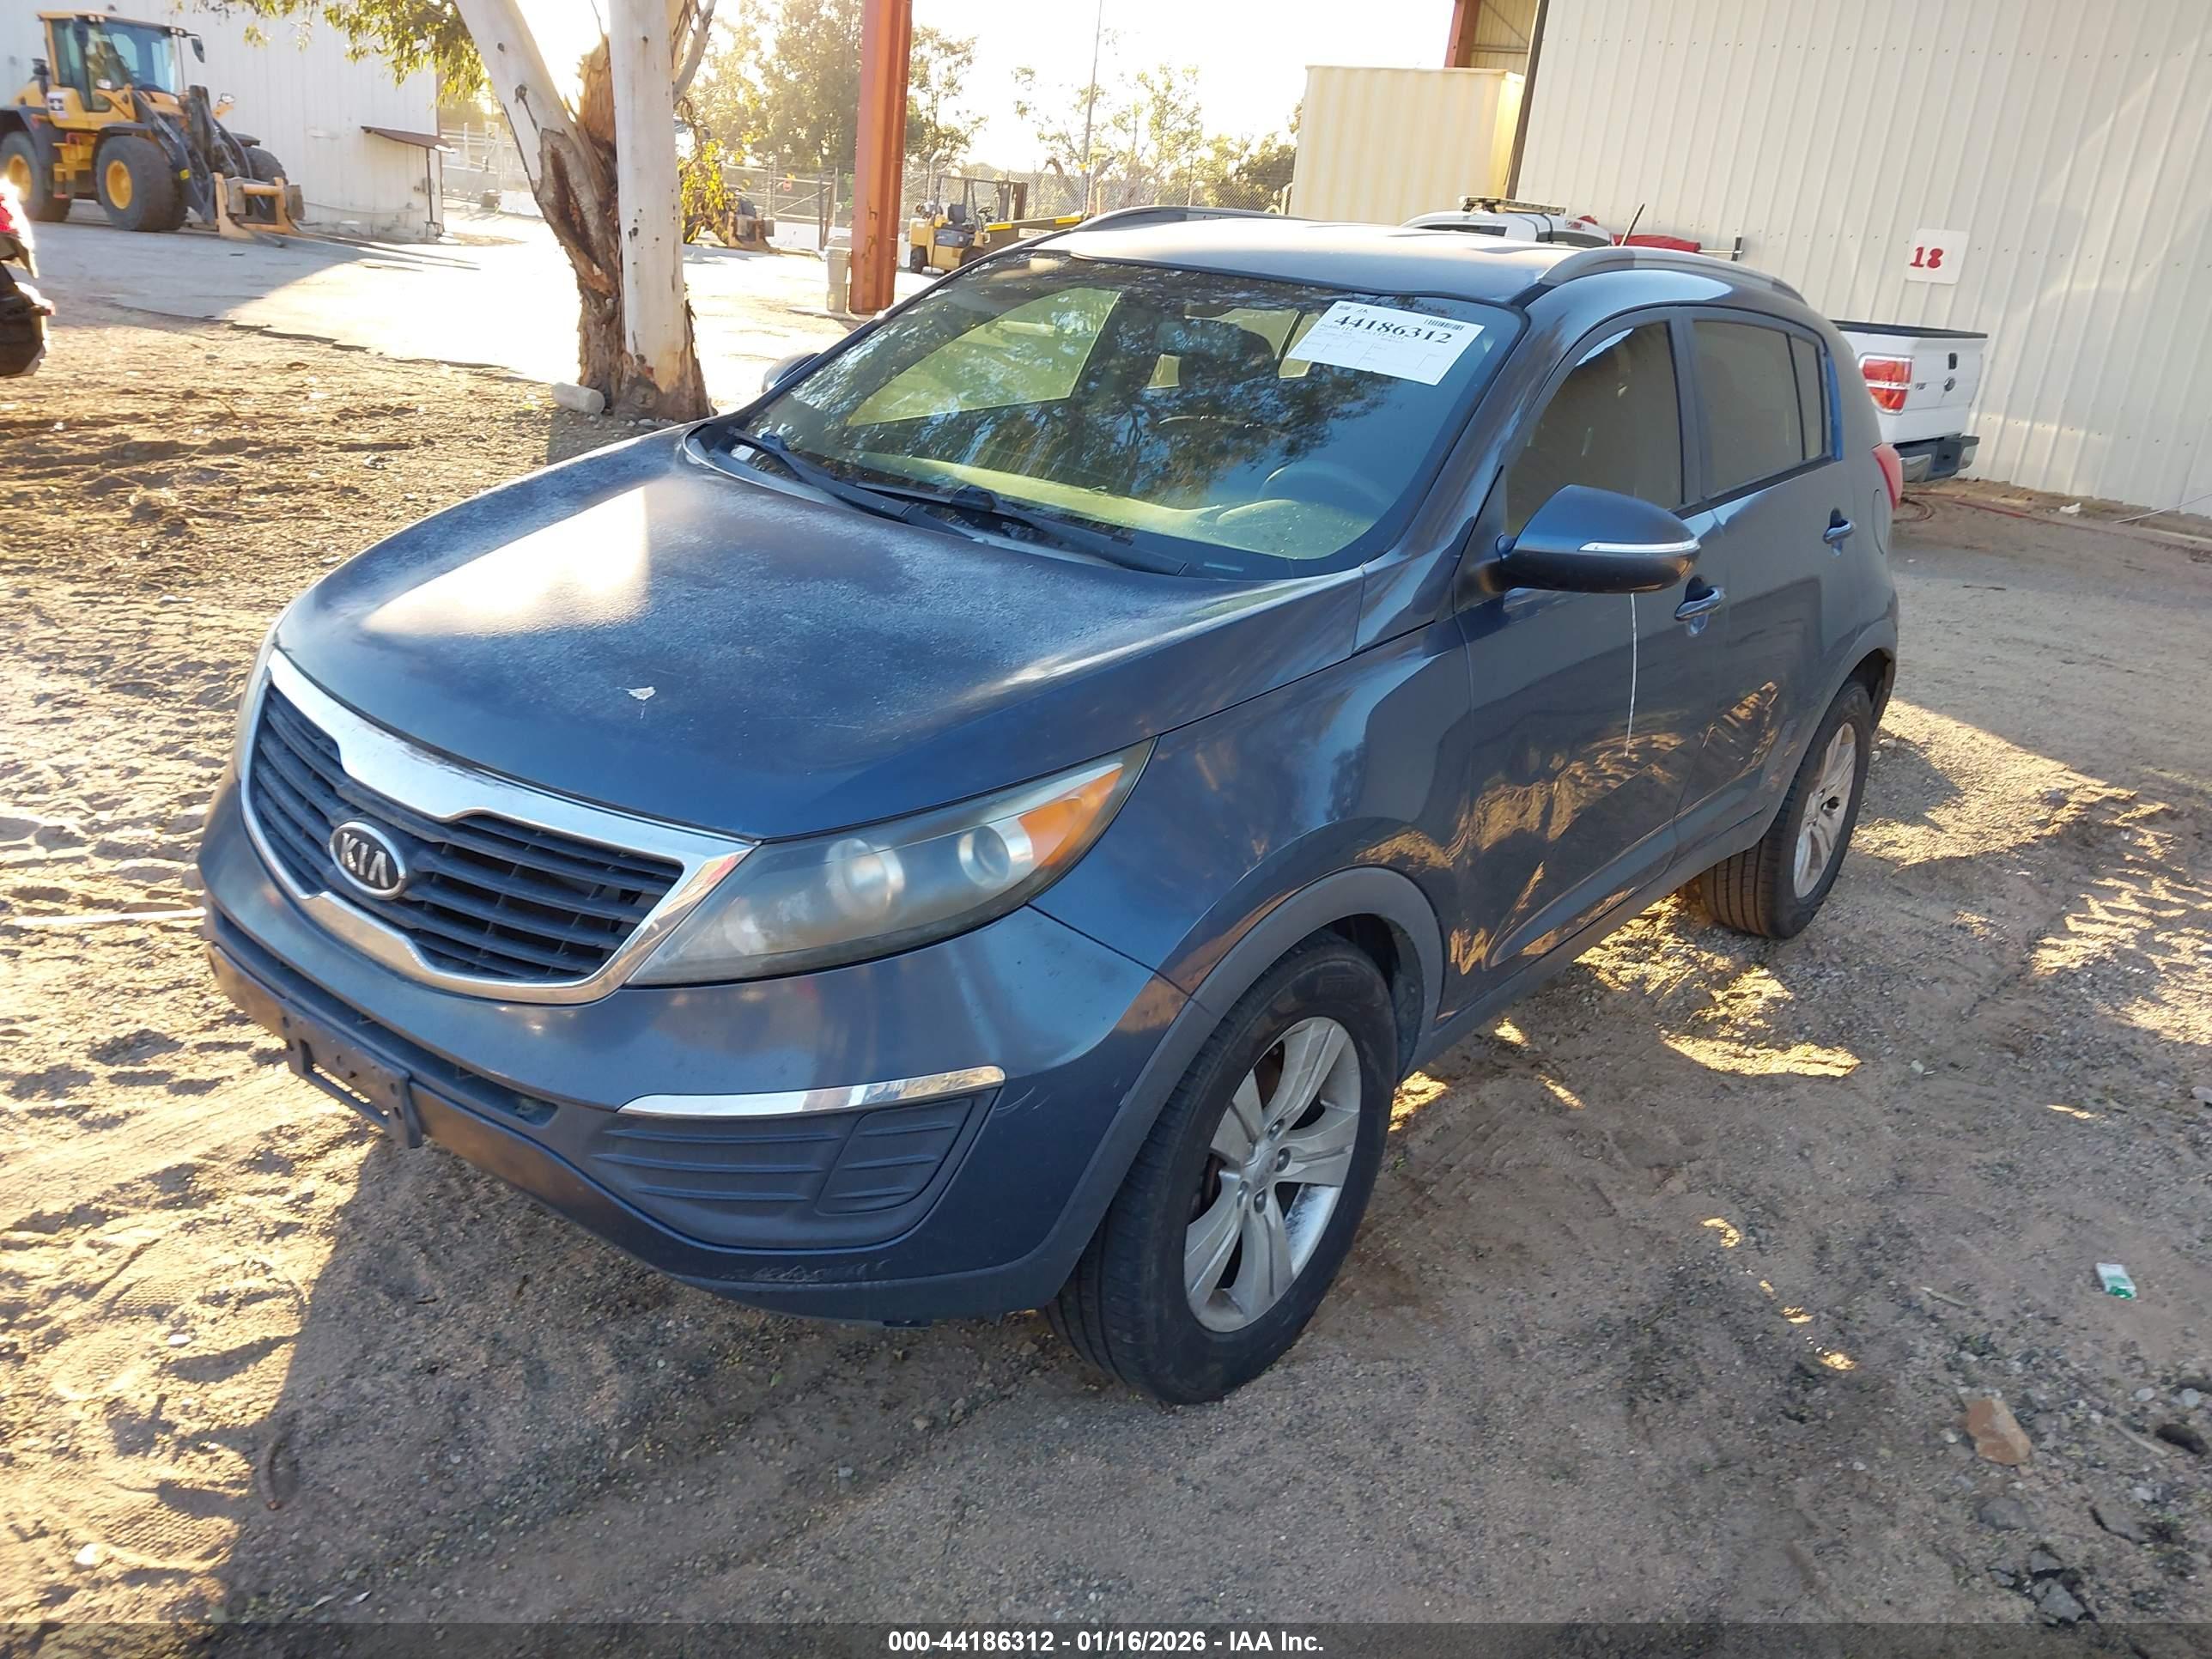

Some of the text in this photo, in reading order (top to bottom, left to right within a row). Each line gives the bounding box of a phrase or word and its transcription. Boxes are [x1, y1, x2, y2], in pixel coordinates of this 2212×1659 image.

[1909, 246, 1944, 269] 18
[1334, 315, 1453, 343] 44186312
[340, 832, 389, 888] KIA
